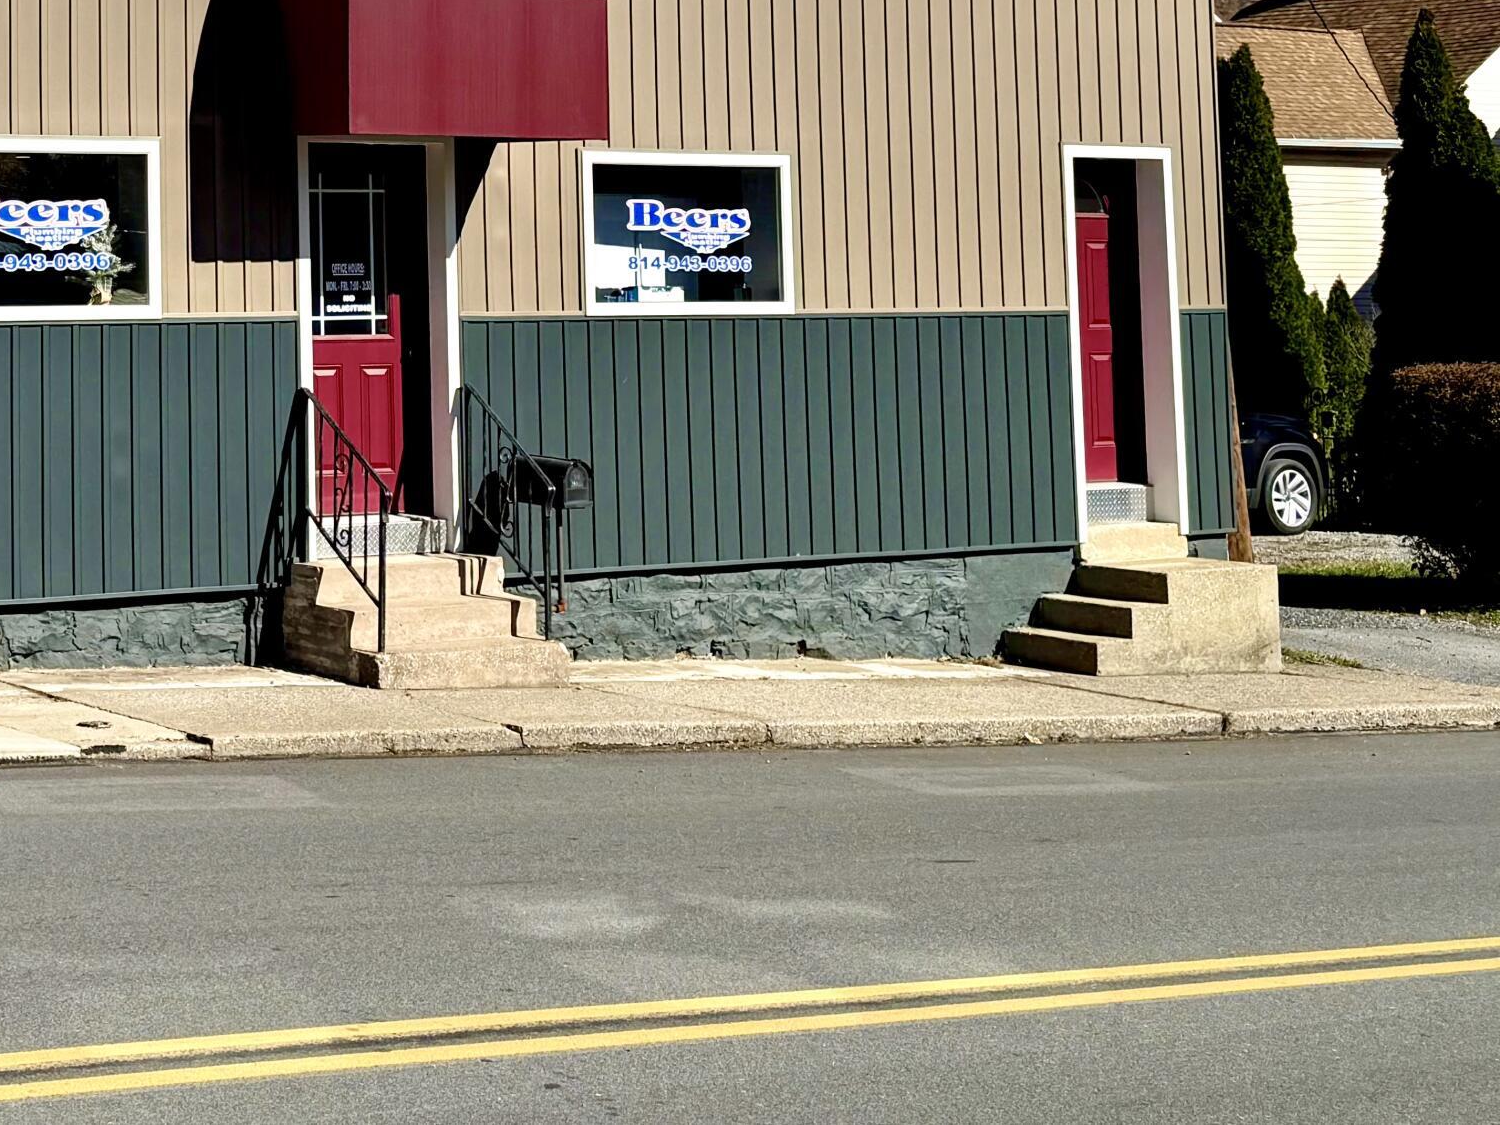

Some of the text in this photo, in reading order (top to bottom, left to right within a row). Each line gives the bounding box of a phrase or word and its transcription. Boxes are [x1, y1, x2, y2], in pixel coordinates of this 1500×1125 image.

[626, 199, 751, 231] Beers
[20, 227, 83, 236] Plumbing
[627, 255, 753, 273] 814-943-0396
